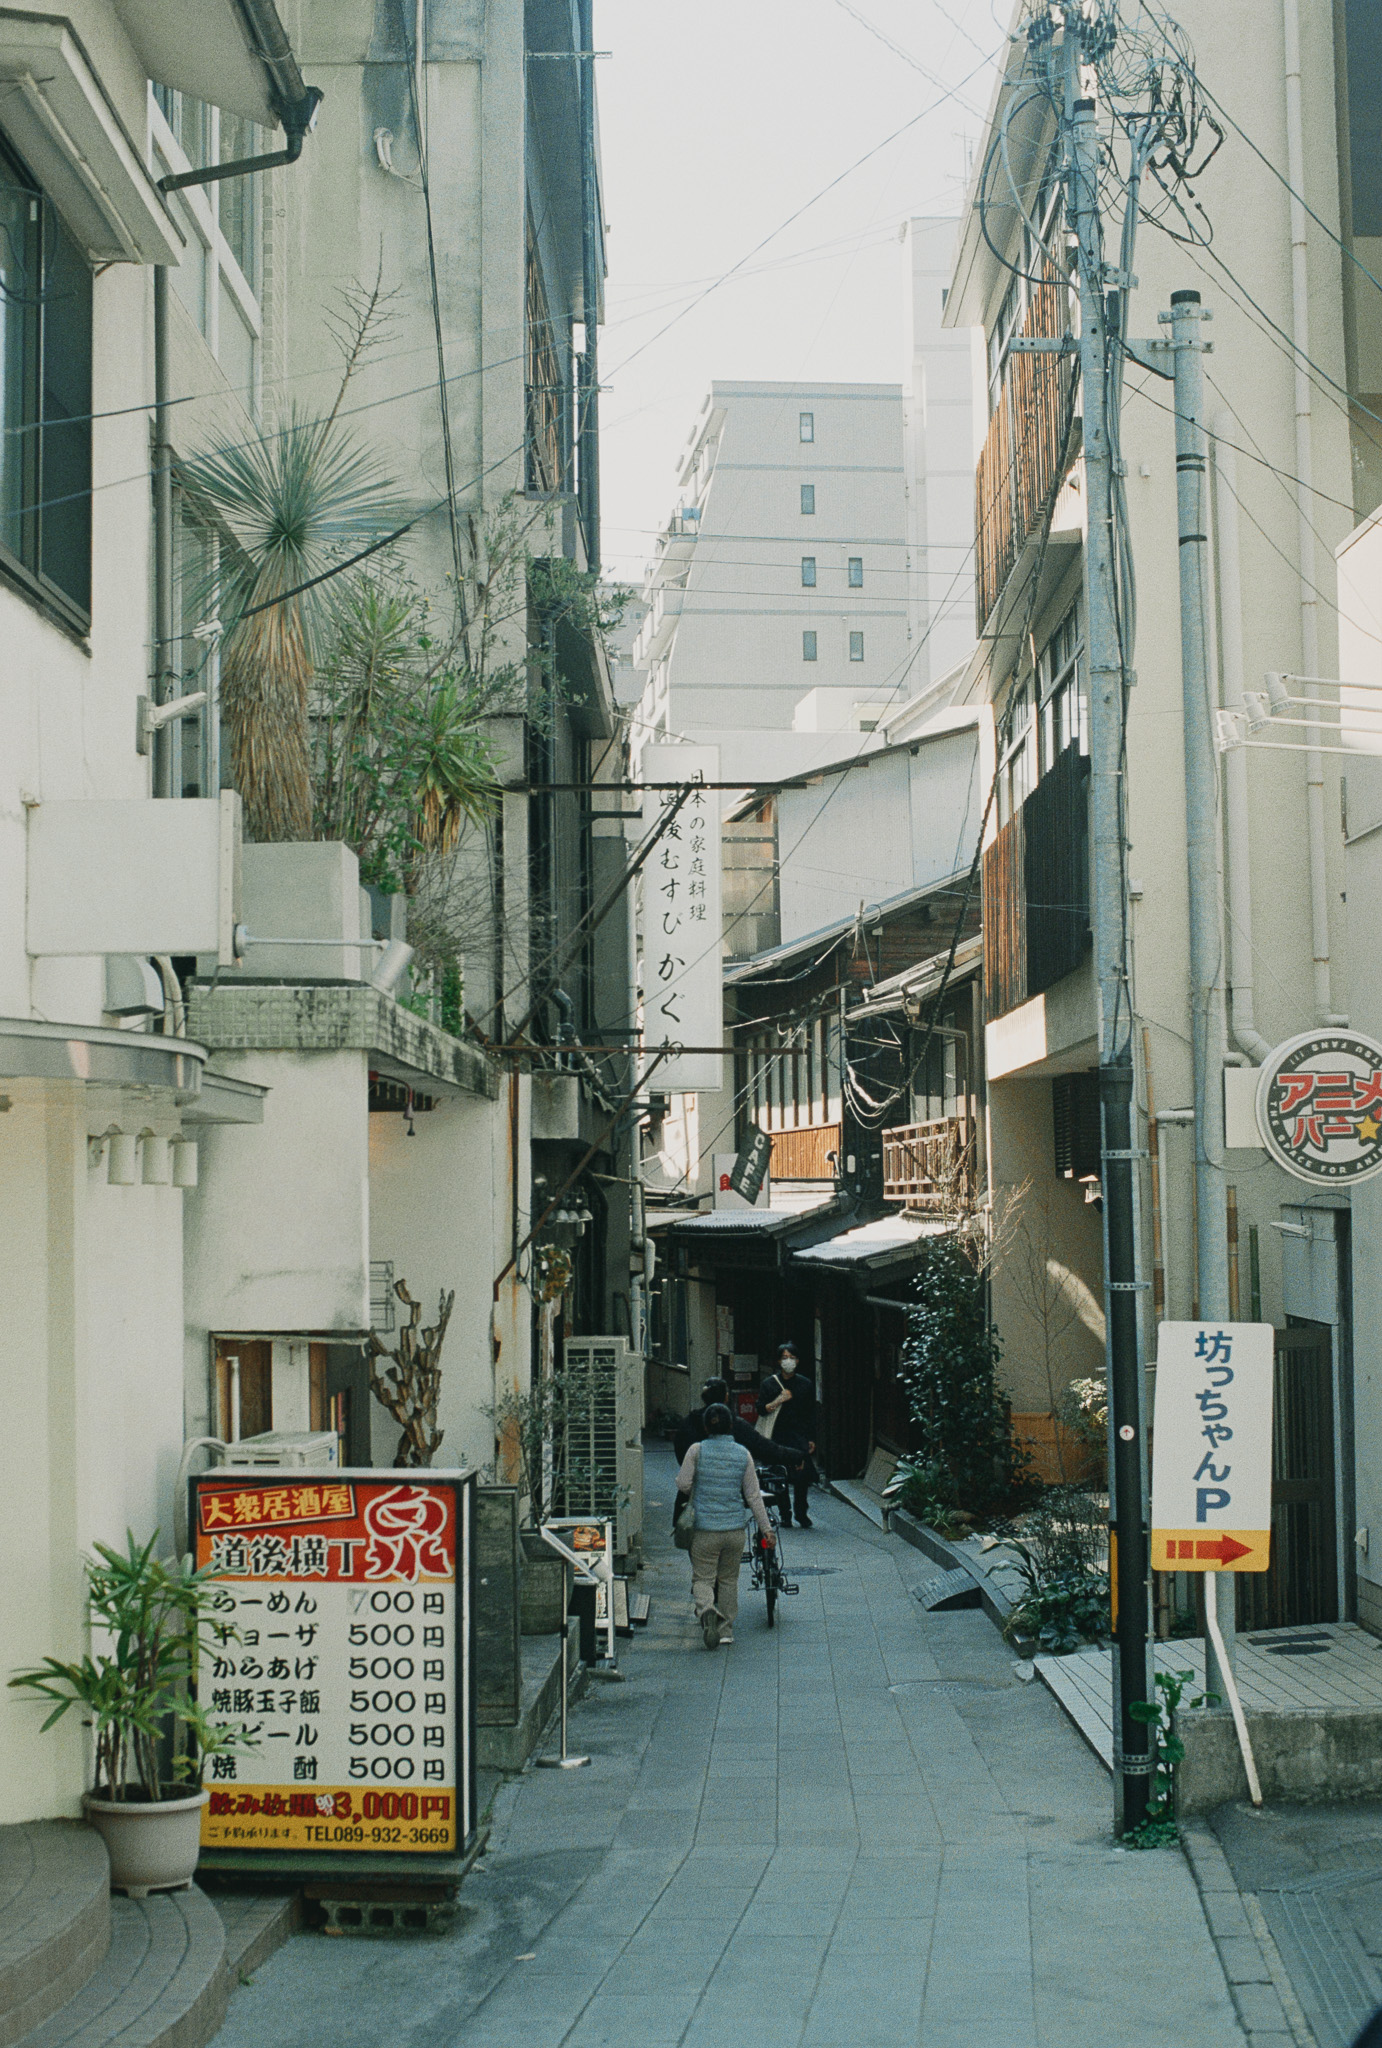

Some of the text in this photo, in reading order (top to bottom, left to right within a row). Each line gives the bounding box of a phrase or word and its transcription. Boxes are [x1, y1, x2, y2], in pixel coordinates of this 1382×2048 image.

[688, 768, 707, 922] 日本の家庭料理
[1311, 1040, 1347, 1052] FANS
[1277, 1070, 1382, 1114] アニメ
[739, 1133, 765, 1193] CAFE
[1320, 1165, 1347, 1174] FOR
[204, 1484, 351, 1528] 大衆居酒屋
[212, 1590, 318, 1613] らーめん
[212, 1655, 319, 1680] からあげ
[212, 1688, 320, 1714] 焼豚玉子飯
